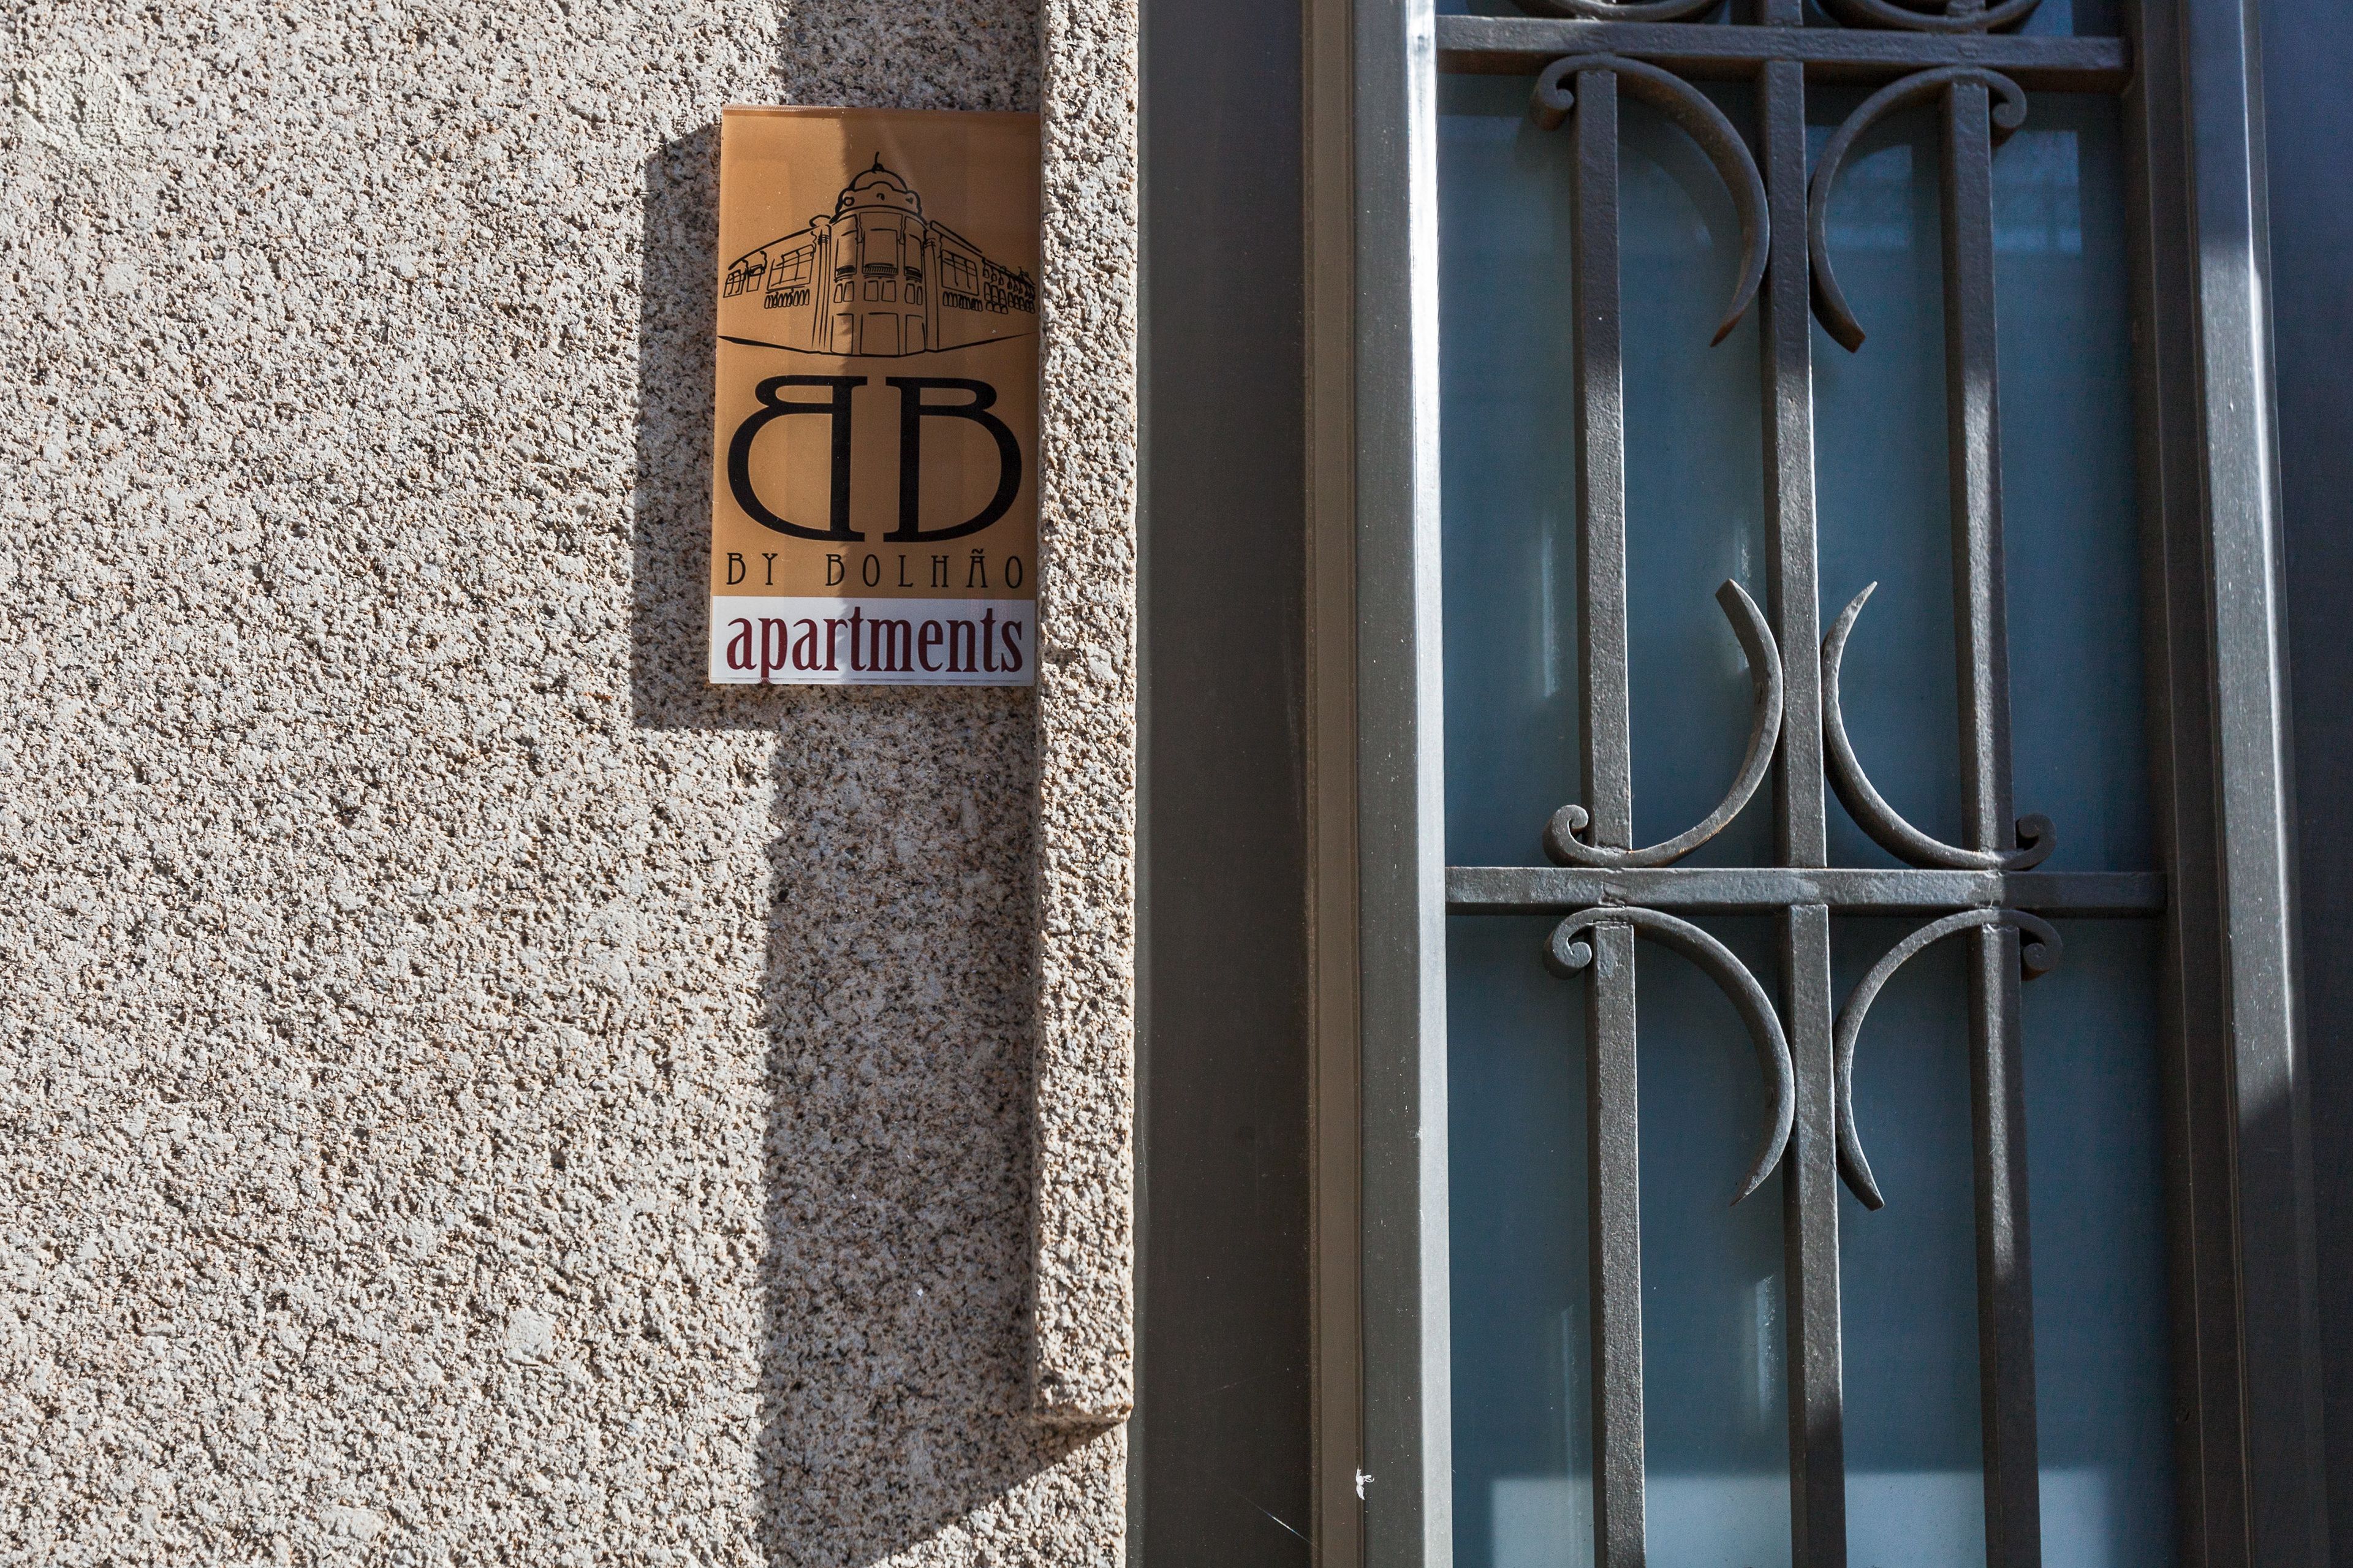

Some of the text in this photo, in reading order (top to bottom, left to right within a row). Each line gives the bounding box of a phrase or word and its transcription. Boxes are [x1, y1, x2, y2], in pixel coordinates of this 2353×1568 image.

[726, 548, 1023, 589] BY BOLHÃO
[726, 606, 1023, 679] apartments
